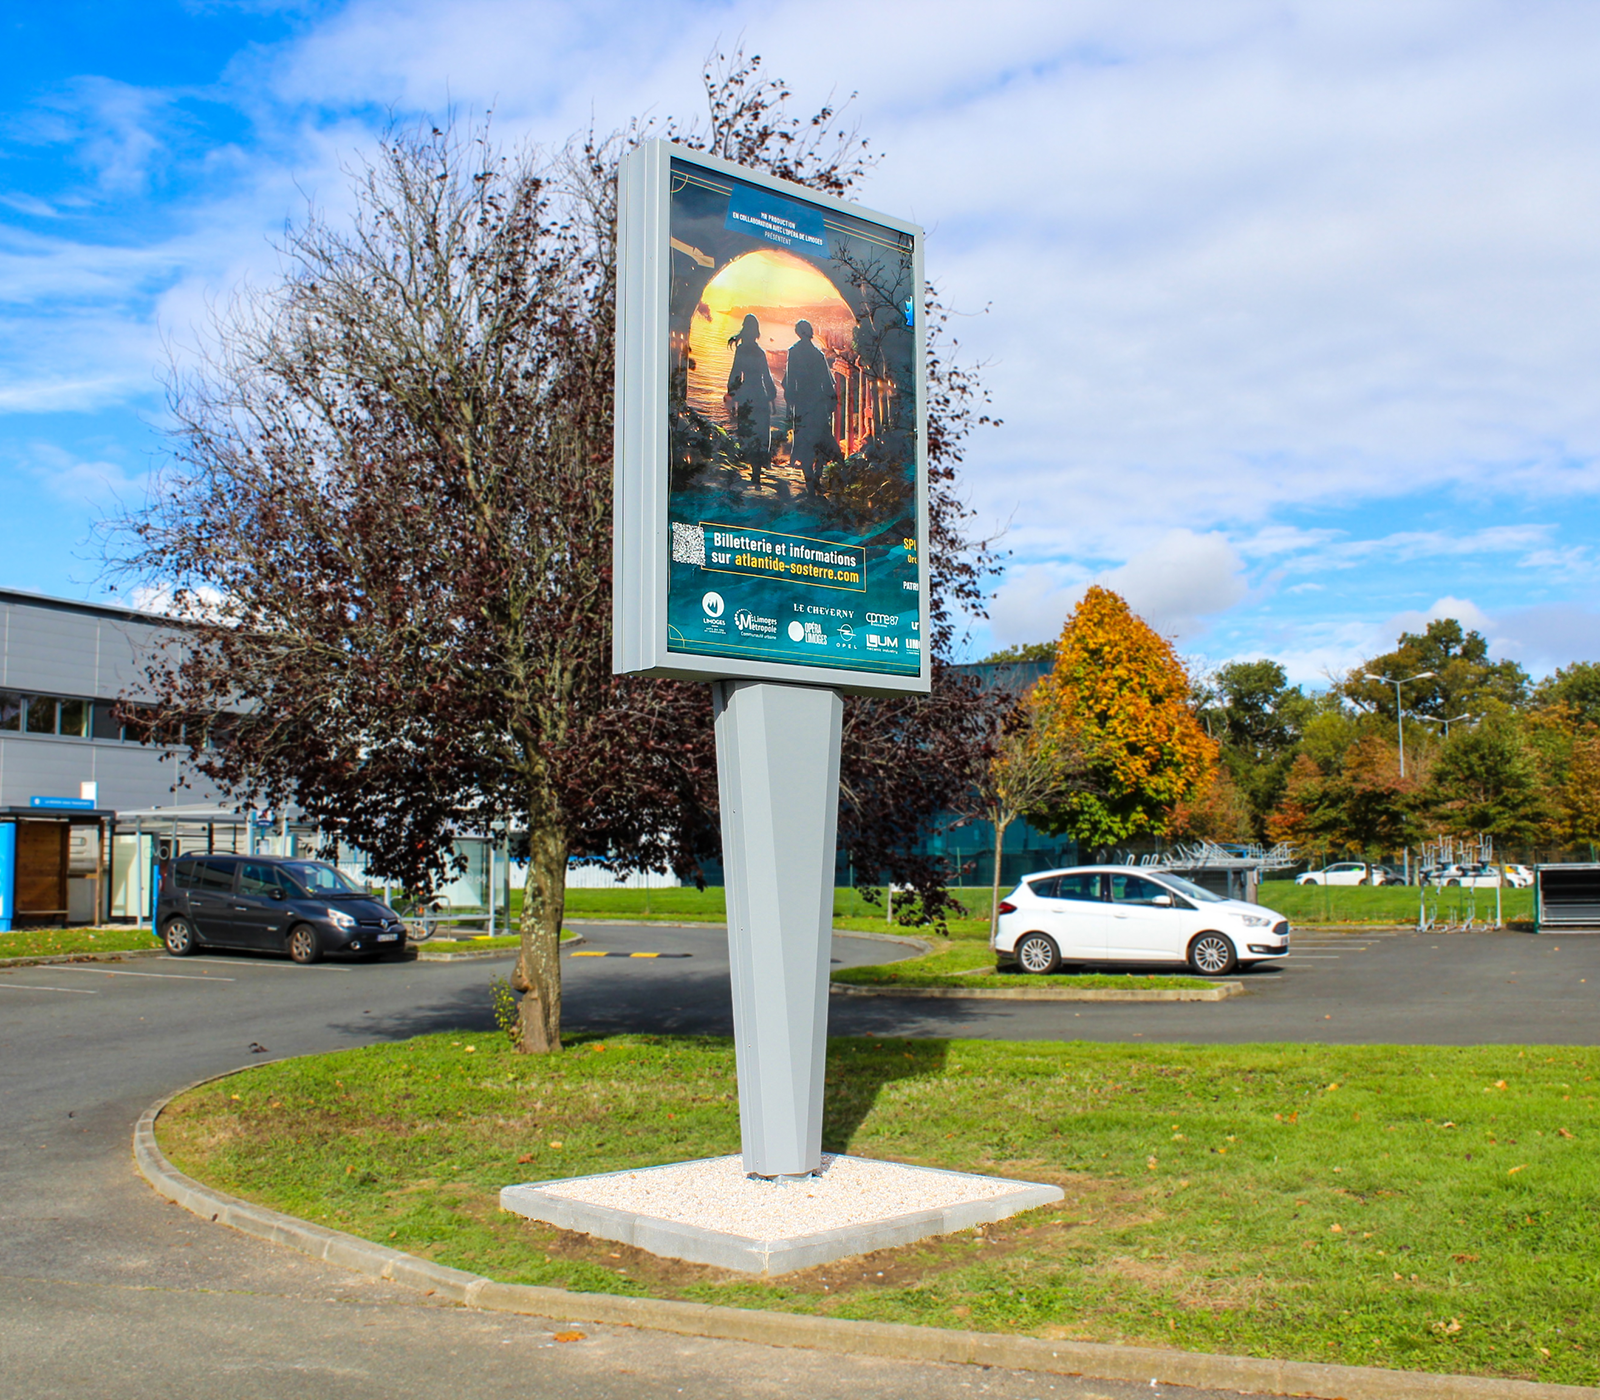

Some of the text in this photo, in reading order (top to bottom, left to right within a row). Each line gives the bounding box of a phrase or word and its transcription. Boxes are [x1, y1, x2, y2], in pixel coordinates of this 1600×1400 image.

[732, 211, 739, 219] EN
[740, 213, 773, 229] COLLABORATION
[772, 224, 783, 233] AVEC
[799, 232, 805, 240] DE
[805, 235, 823, 246] LIMOGES
[768, 214, 796, 229] PRODUCTION
[713, 532, 856, 567] Billetterie et informations
[711, 551, 860, 583] sur atlantide-sosterre.com
[793, 603, 855, 619] LE CHEVERNY
[703, 618, 726, 626] LIMOGES
[753, 616, 778, 626] Limoges
[804, 621, 822, 634] OPÉRA
[804, 632, 828, 646] LIMOGES
[835, 642, 858, 650] OPEL
